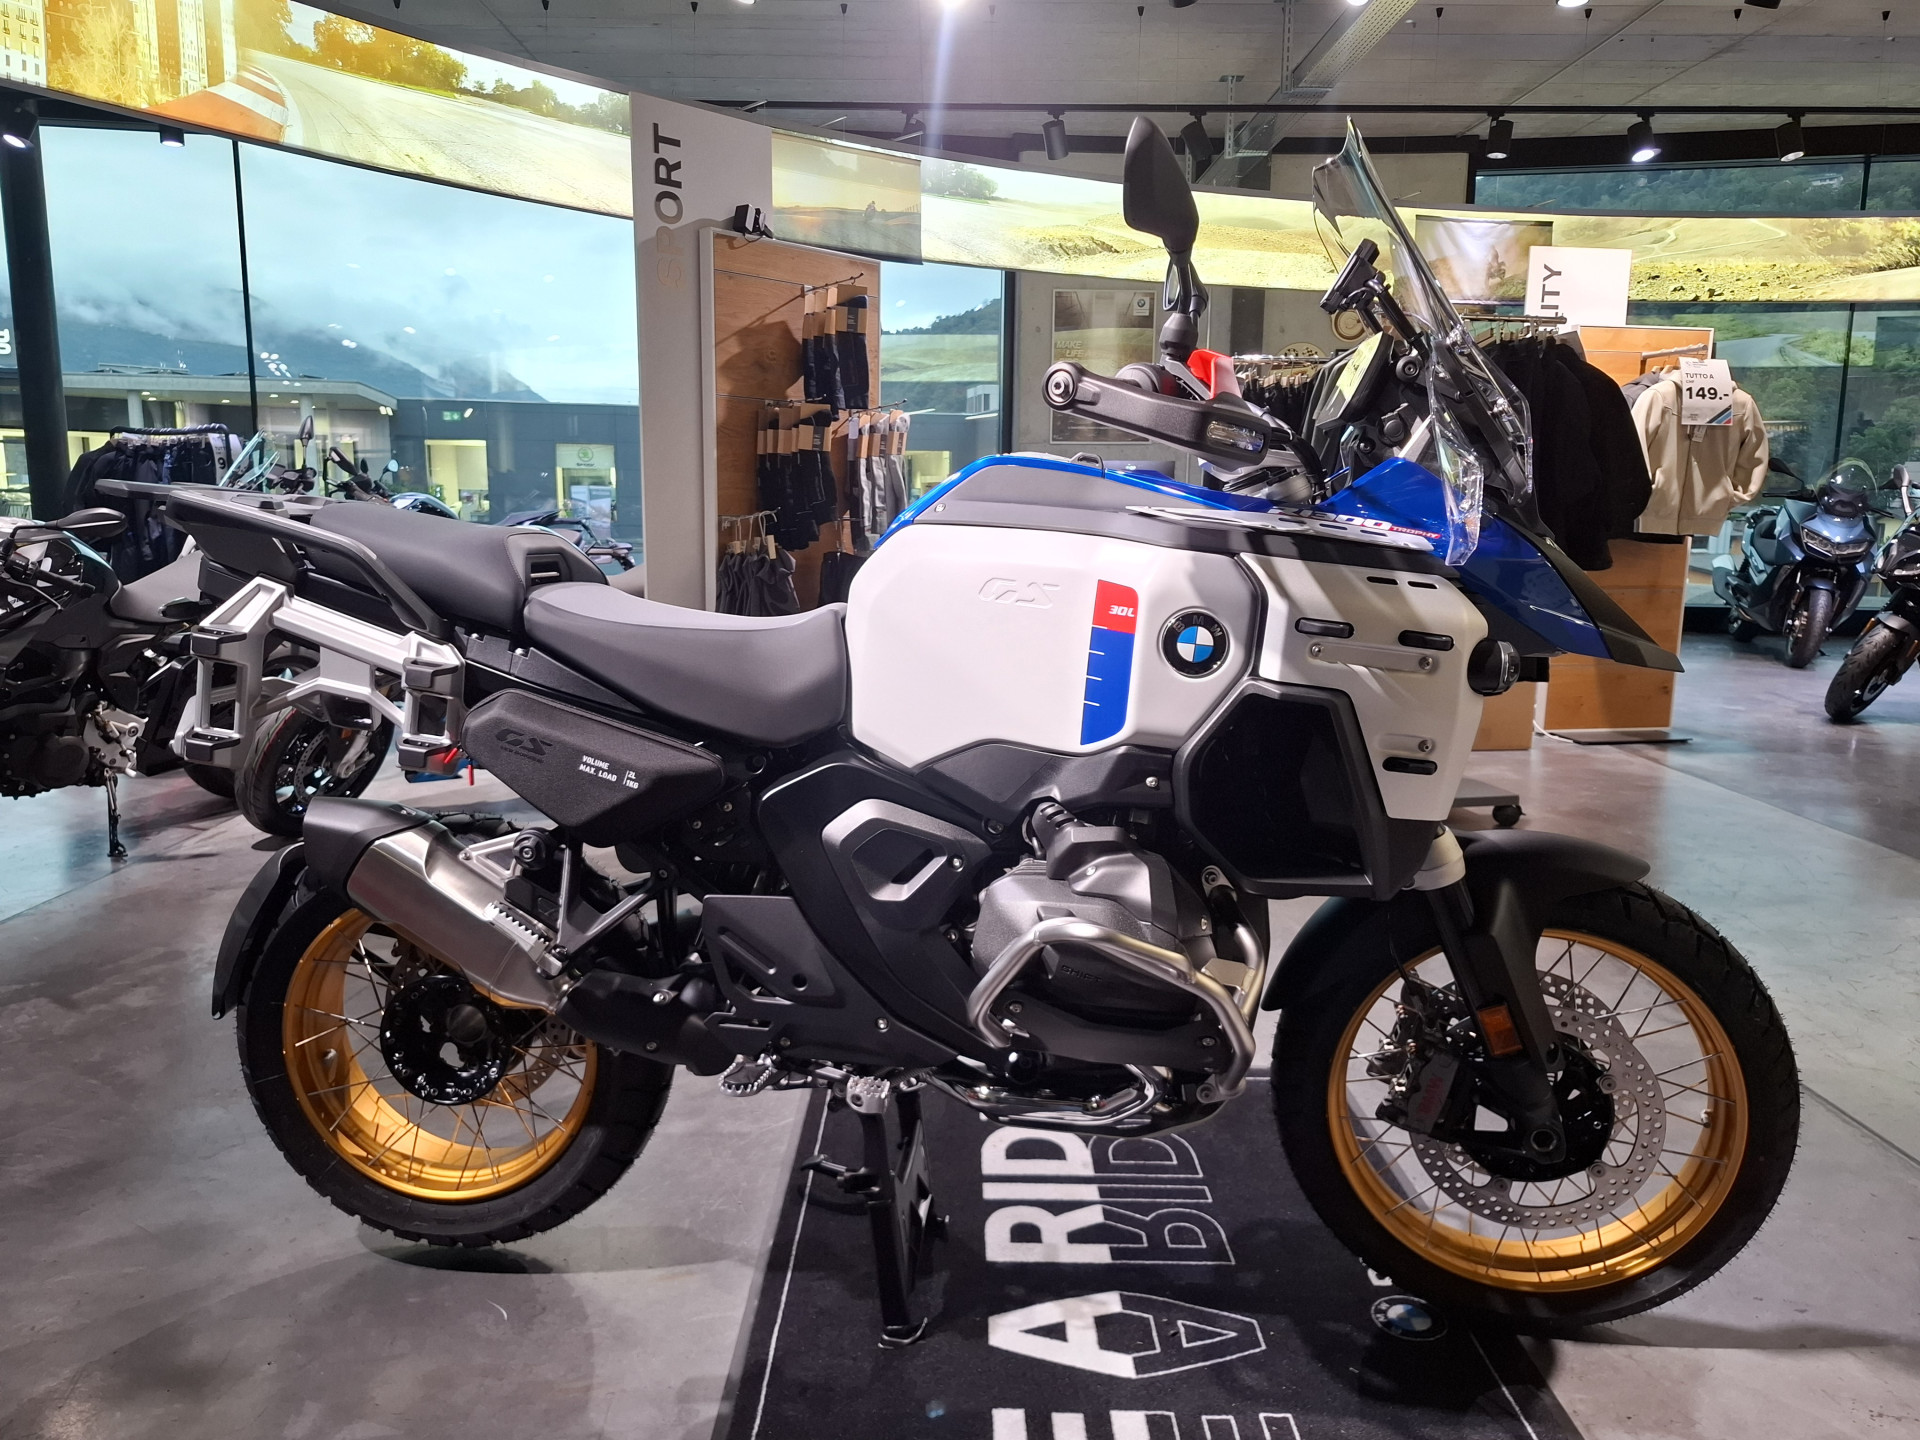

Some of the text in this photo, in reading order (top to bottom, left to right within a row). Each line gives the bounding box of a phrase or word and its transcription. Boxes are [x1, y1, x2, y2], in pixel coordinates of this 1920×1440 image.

[652, 122, 684, 289] SPORT
[1540, 263, 1562, 317] ITY
[1685, 386, 1729, 400] 149.-
[1392, 526, 1440, 539] TROPHY
[978, 577, 1061, 609] GS
[1108, 604, 1135, 618] 30L
[1172, 614, 1223, 638] BMW
[495, 728, 553, 756] GS
[582, 755, 610, 770] VOLUME
[579, 763, 617, 782] MAX. LOAD
[628, 771, 636, 779] 2L
[626, 779, 639, 789] 1KG
[1061, 964, 1103, 982] SHIFT
